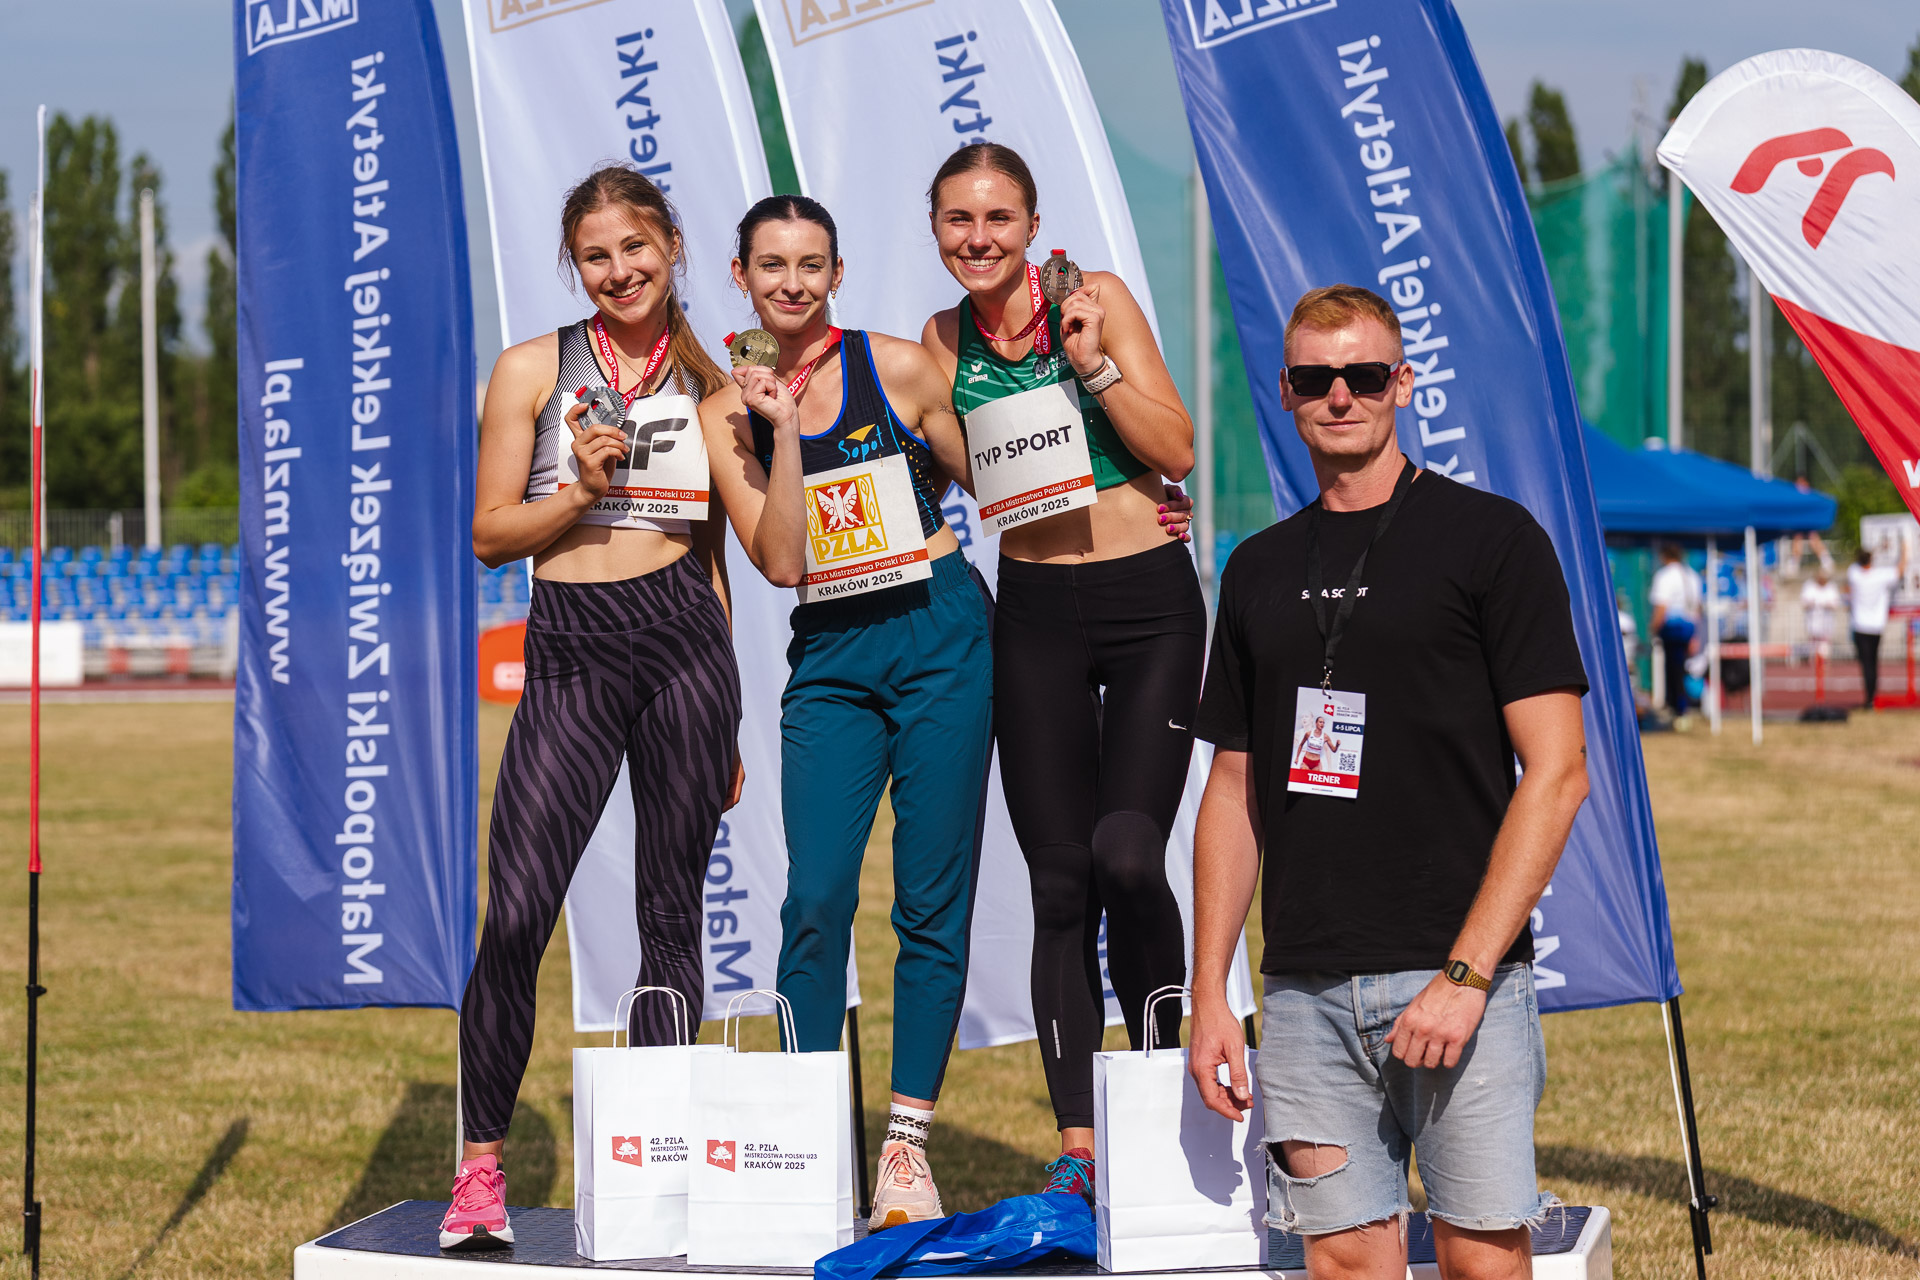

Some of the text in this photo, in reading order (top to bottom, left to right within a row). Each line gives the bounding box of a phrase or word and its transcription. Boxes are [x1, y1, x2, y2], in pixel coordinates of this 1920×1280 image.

[968, 372, 988, 384] erima
[837, 424, 885, 463] Sopot
[974, 425, 1072, 470] TVP SPORT
[607, 487, 653, 497] Mistrzostwa
[654, 490, 678, 499] Polski
[993, 503, 1006, 513] PZLA
[1005, 491, 1043, 508] Mistrzostwa
[1044, 483, 1066, 496] Polski
[1066, 479, 1082, 489] U23
[589, 499, 679, 514] RAKÓW 2025
[996, 496, 1070, 528] KRAKÓW 2025
[815, 528, 883, 561] PZLA
[813, 573, 829, 582] PZLA
[829, 564, 874, 579] Mistrzostwa
[874, 558, 898, 569] Polski
[899, 553, 915, 563] U23
[817, 570, 903, 597] KRAKÓW 2025
[1345, 725, 1361, 733] LIPCA
[1308, 773, 1340, 785] TRENER
[650, 1136, 684, 1145] 42. PZLA
[744, 1143, 779, 1152] 42. PZLA
[650, 1151, 688, 1163] KRAKÓW
[744, 1159, 806, 1170] KRAKÓW 2025
